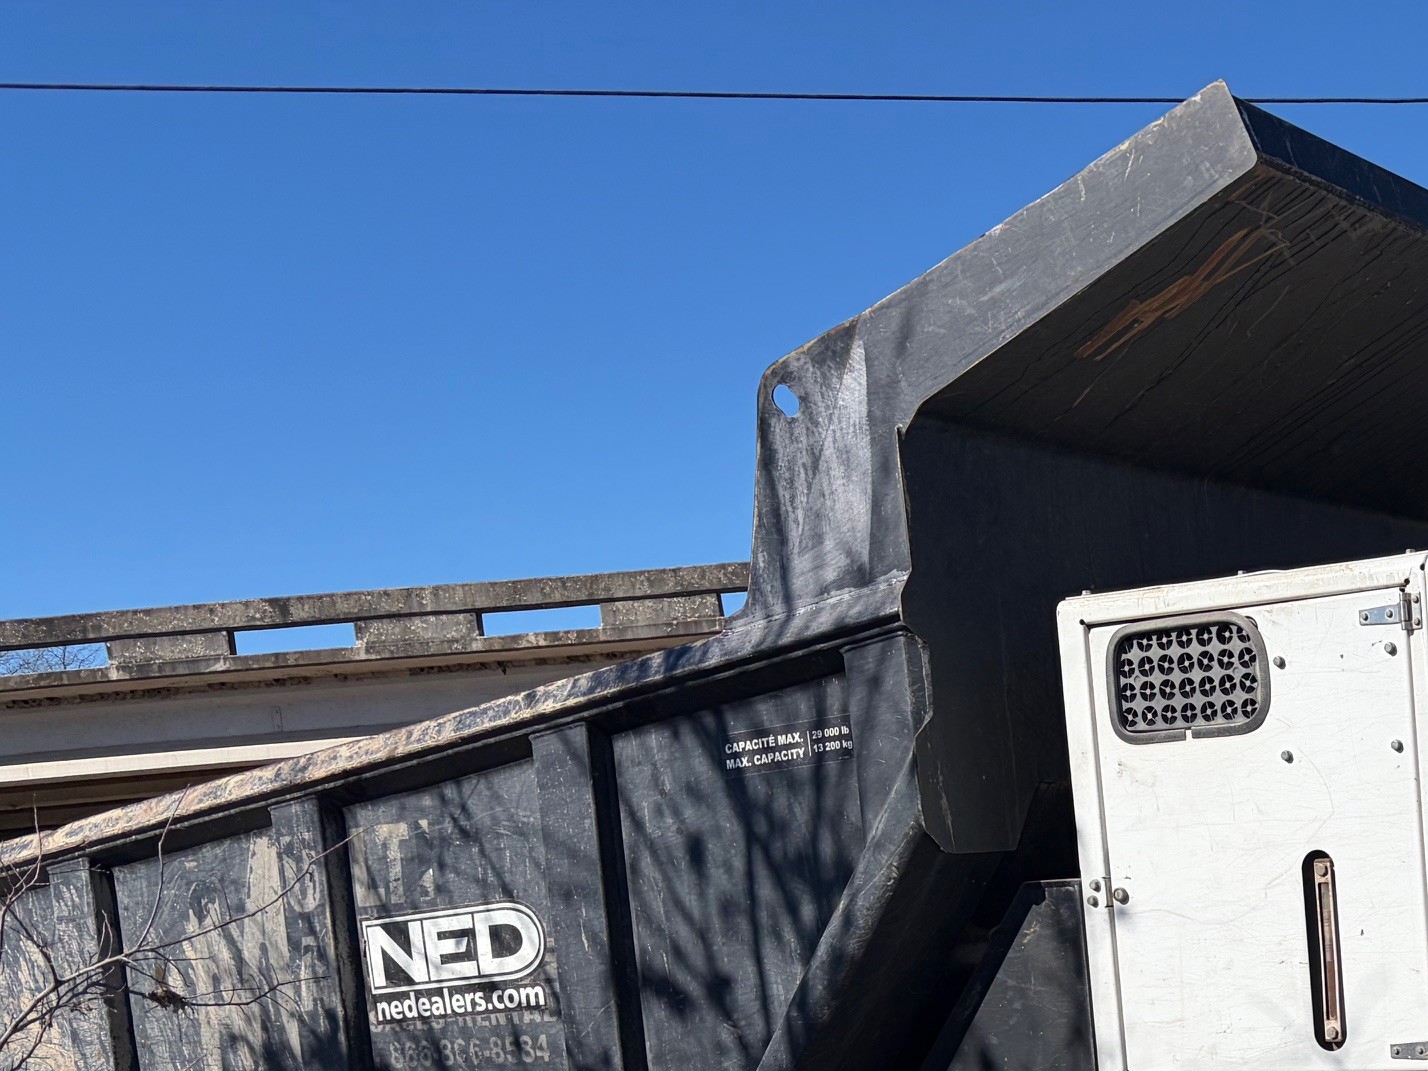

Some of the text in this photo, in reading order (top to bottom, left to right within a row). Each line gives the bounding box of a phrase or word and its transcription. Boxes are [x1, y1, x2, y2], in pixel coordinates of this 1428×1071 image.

[725, 731, 804, 754] CAPACITÉ MAX.
[811, 725, 850, 740] 29 000 lb
[813, 740, 853, 753] 13 200 kg
[726, 747, 805, 770] MAX. CAPACITY
[366, 908, 542, 988] NED
[377, 985, 546, 1022] nedealers.com
